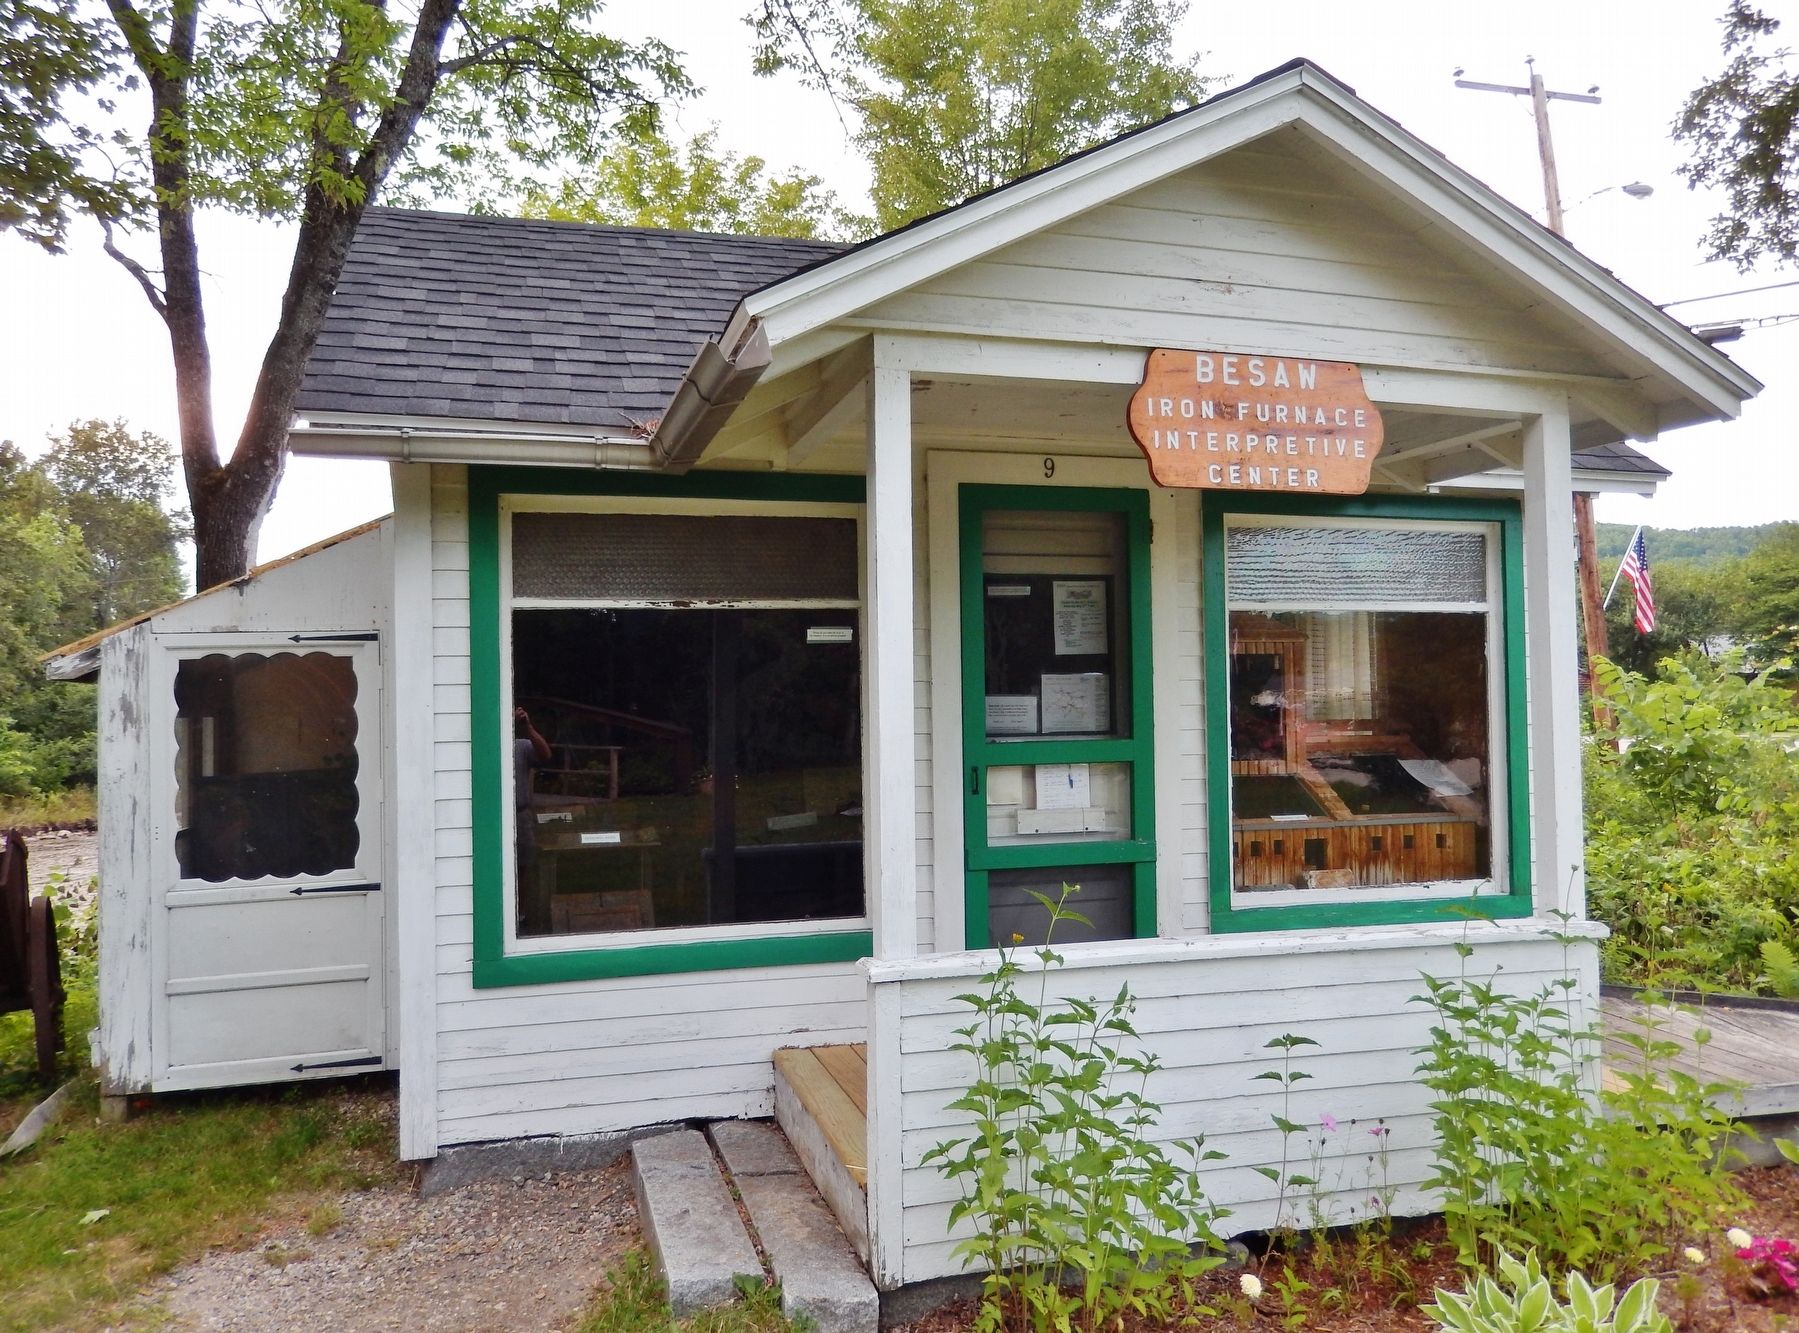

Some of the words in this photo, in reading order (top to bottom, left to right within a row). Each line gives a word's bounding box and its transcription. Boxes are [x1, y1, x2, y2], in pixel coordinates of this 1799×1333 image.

[1196, 355, 1316, 390] BESAW
[1147, 398, 1214, 419] IRON
[1238, 403, 1366, 428] FURNACE
[1154, 430, 1366, 458] INTERPRETIVE
[1044, 457, 1055, 478] 9
[1208, 464, 1319, 487] CENTER
